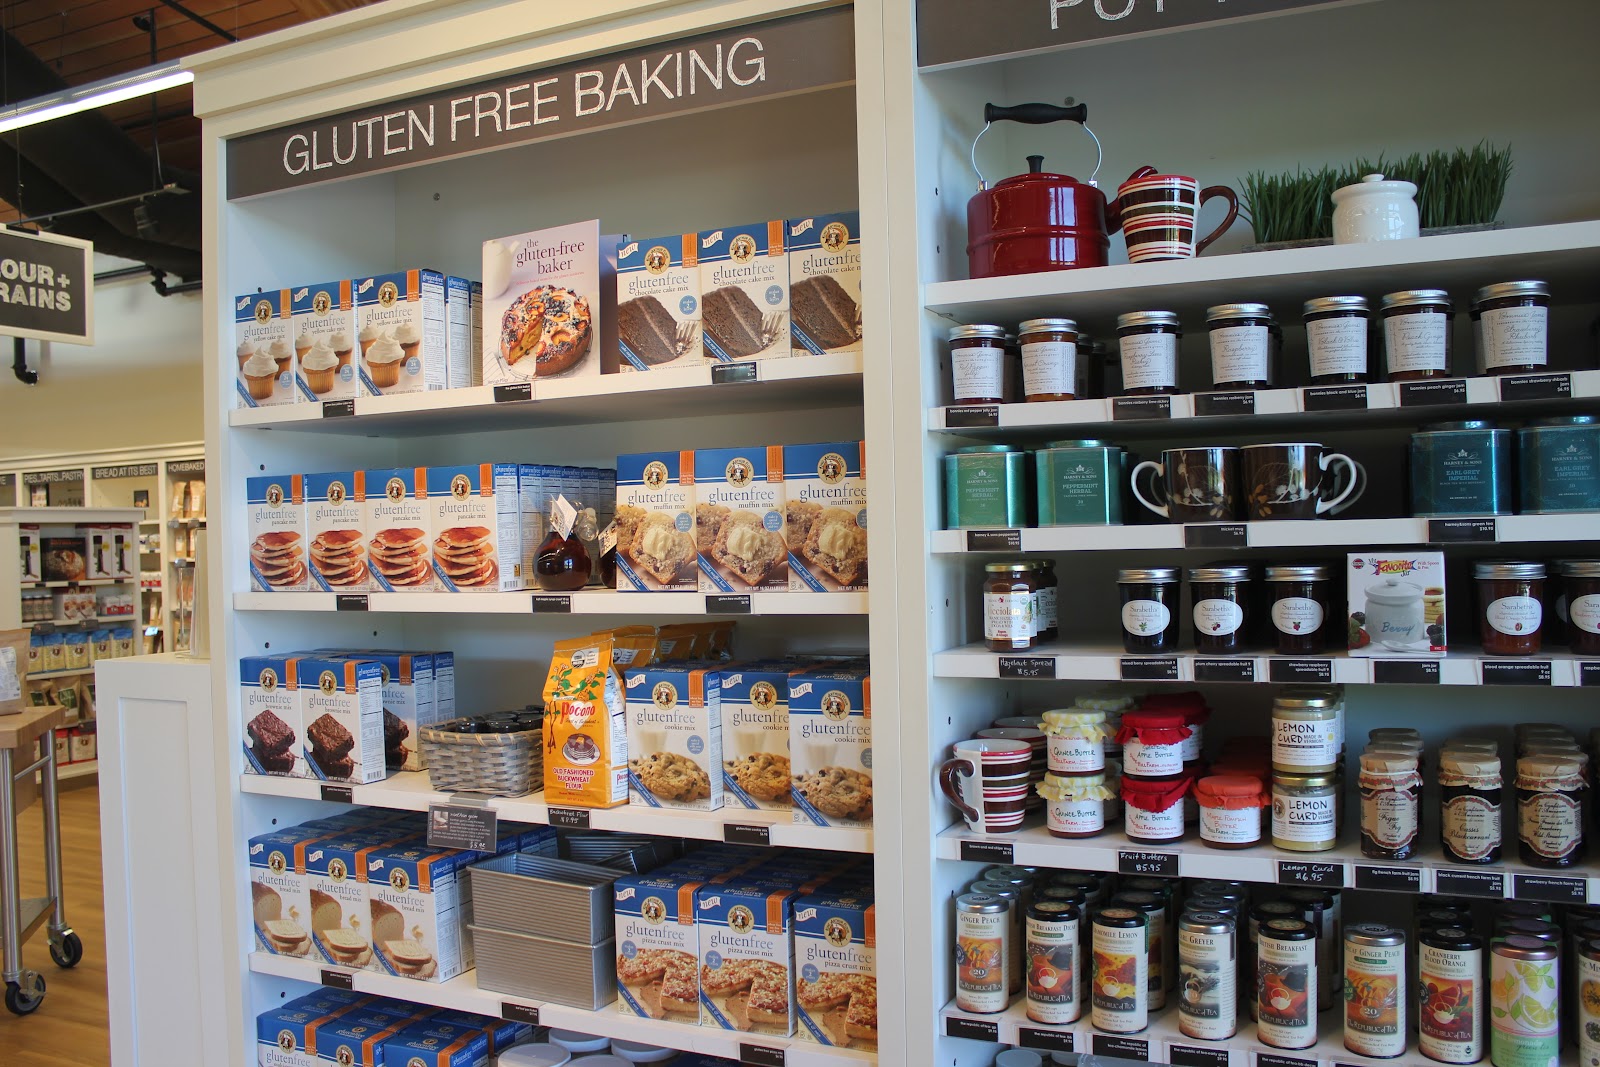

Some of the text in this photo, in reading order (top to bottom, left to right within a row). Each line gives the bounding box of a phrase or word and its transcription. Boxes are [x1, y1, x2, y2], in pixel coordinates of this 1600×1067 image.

[282, 37, 766, 175] GLUTEN FREE BAKING
[794, 220, 812, 234] new
[527, 239, 538, 248] the
[705, 233, 721, 246] new
[516, 241, 585, 268] gluten-free
[620, 244, 637, 256] new
[538, 259, 573, 274] baker
[713, 262, 775, 284] glutenfree
[628, 272, 689, 295] glutenfree
[720, 278, 746, 287] chocolate
[635, 288, 661, 296] chocolate
[366, 305, 412, 325] glutenfree
[302, 315, 345, 334] glutenfree
[244, 323, 285, 340] glutenfree
[96, 468, 118, 478] BREAD
[119, 468, 128, 477] AT
[140, 465, 157, 474] BEST
[168, 463, 204, 471] HOMEBAKED
[628, 490, 686, 509] glutenfree
[708, 488, 774, 508] glutenfree
[374, 502, 421, 520] glutenfree
[439, 501, 486, 519] glutenfree
[653, 502, 672, 510] muffin
[255, 508, 296, 522] glutenfree
[316, 505, 359, 521] glutenfree
[1376, 560, 1413, 575] Favorite
[1381, 622, 1415, 635] Berry
[628, 676, 644, 687] new
[724, 676, 741, 687] new
[793, 684, 810, 697] new
[249, 692, 291, 708] glutenfree
[309, 696, 350, 708] glutenfree
[562, 702, 595, 724] Pocono
[637, 710, 695, 725] glutenfree
[802, 720, 871, 737] glutenfree
[1278, 722, 1315, 733] LEMON
[1278, 734, 1303, 744] CURD
[1075, 748, 1095, 756] BUTTER
[1289, 800, 1327, 810] LEMON
[1077, 809, 1097, 817] BUTTER
[1289, 811, 1317, 821] CURD
[258, 873, 300, 888] glutenfree
[1295, 873, 1323, 882] $6.95
[317, 880, 362, 896] glutenfree
[617, 889, 635, 900] new
[378, 890, 424, 907] glutenfree
[702, 897, 719, 908] new
[797, 910, 815, 920] new
[626, 922, 684, 939] glutenfree
[642, 937, 656, 945] pizza
[710, 931, 773, 949] glutenfree
[1190, 935, 1214, 946] GREYER
[728, 946, 743, 955] pizza
[744, 948, 760, 956] crust
[807, 943, 872, 964] glutenfree
[1428, 949, 1460, 960] CRANBERRY
[1442, 959, 1466, 967] ORANGE
